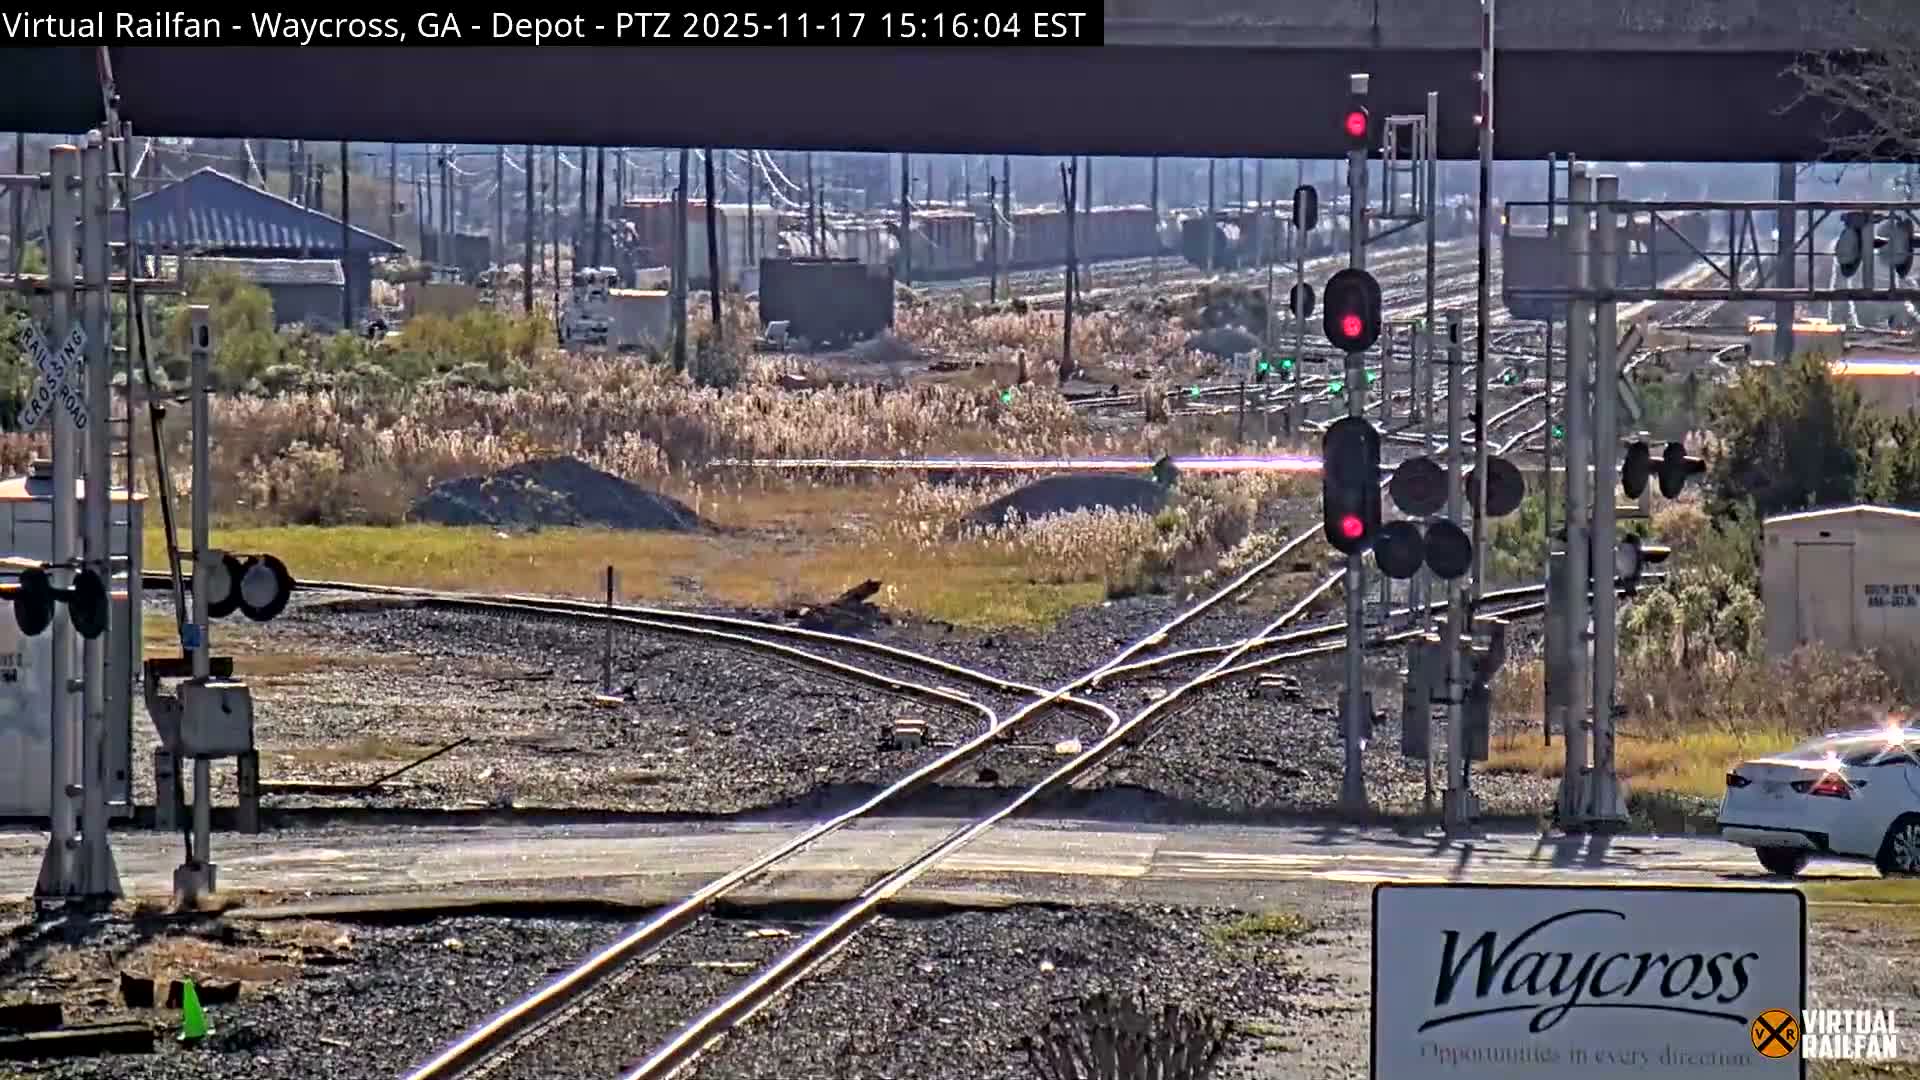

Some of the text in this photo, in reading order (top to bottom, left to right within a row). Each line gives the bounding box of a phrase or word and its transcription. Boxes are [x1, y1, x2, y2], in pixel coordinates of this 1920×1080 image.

[23, 327, 88, 429] RAIL ROAD
[24, 330, 83, 425] CROSSING
[1433, 908, 1760, 1032] Waycross
[1420, 1041, 1560, 1071] Opportunities
[1569, 1041, 1588, 1065] in
[1594, 1049, 1649, 1071] every
